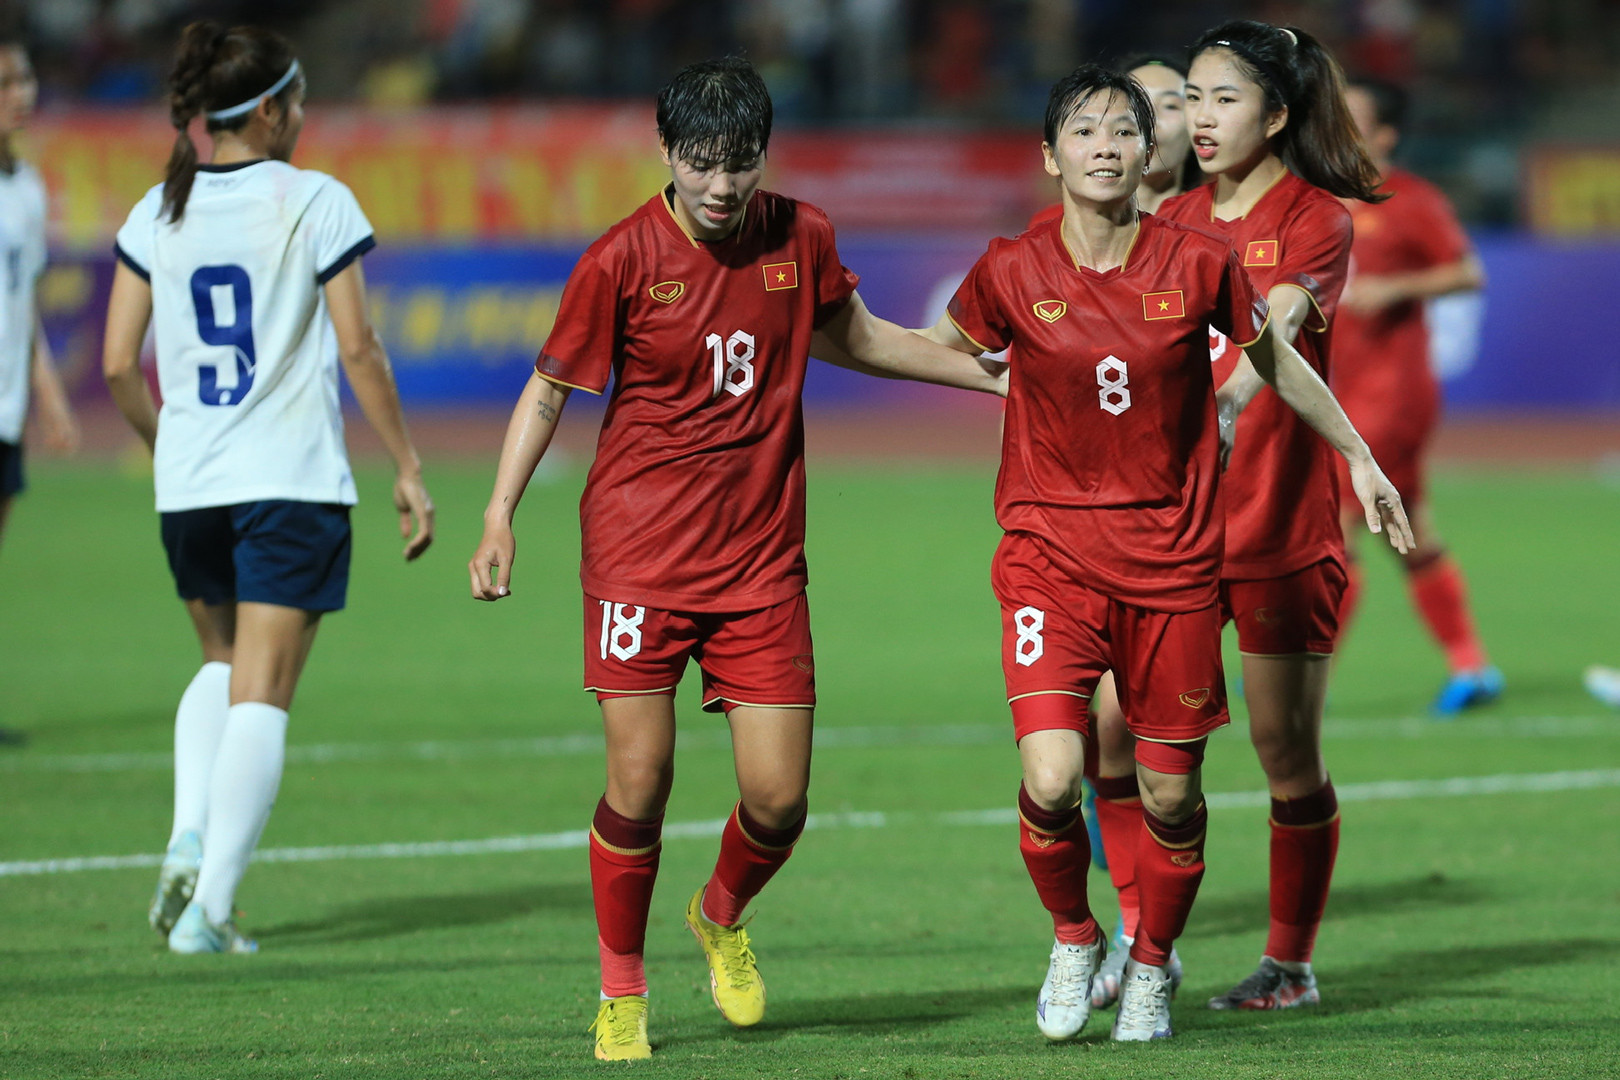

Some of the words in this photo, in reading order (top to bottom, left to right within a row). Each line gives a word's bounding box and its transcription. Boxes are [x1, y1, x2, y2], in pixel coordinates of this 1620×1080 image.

[190, 264, 256, 406] 9
[705, 329, 755, 398] 18
[1095, 354, 1132, 417] 8
[599, 599, 646, 662] 18
[1013, 605, 1045, 668] 8
